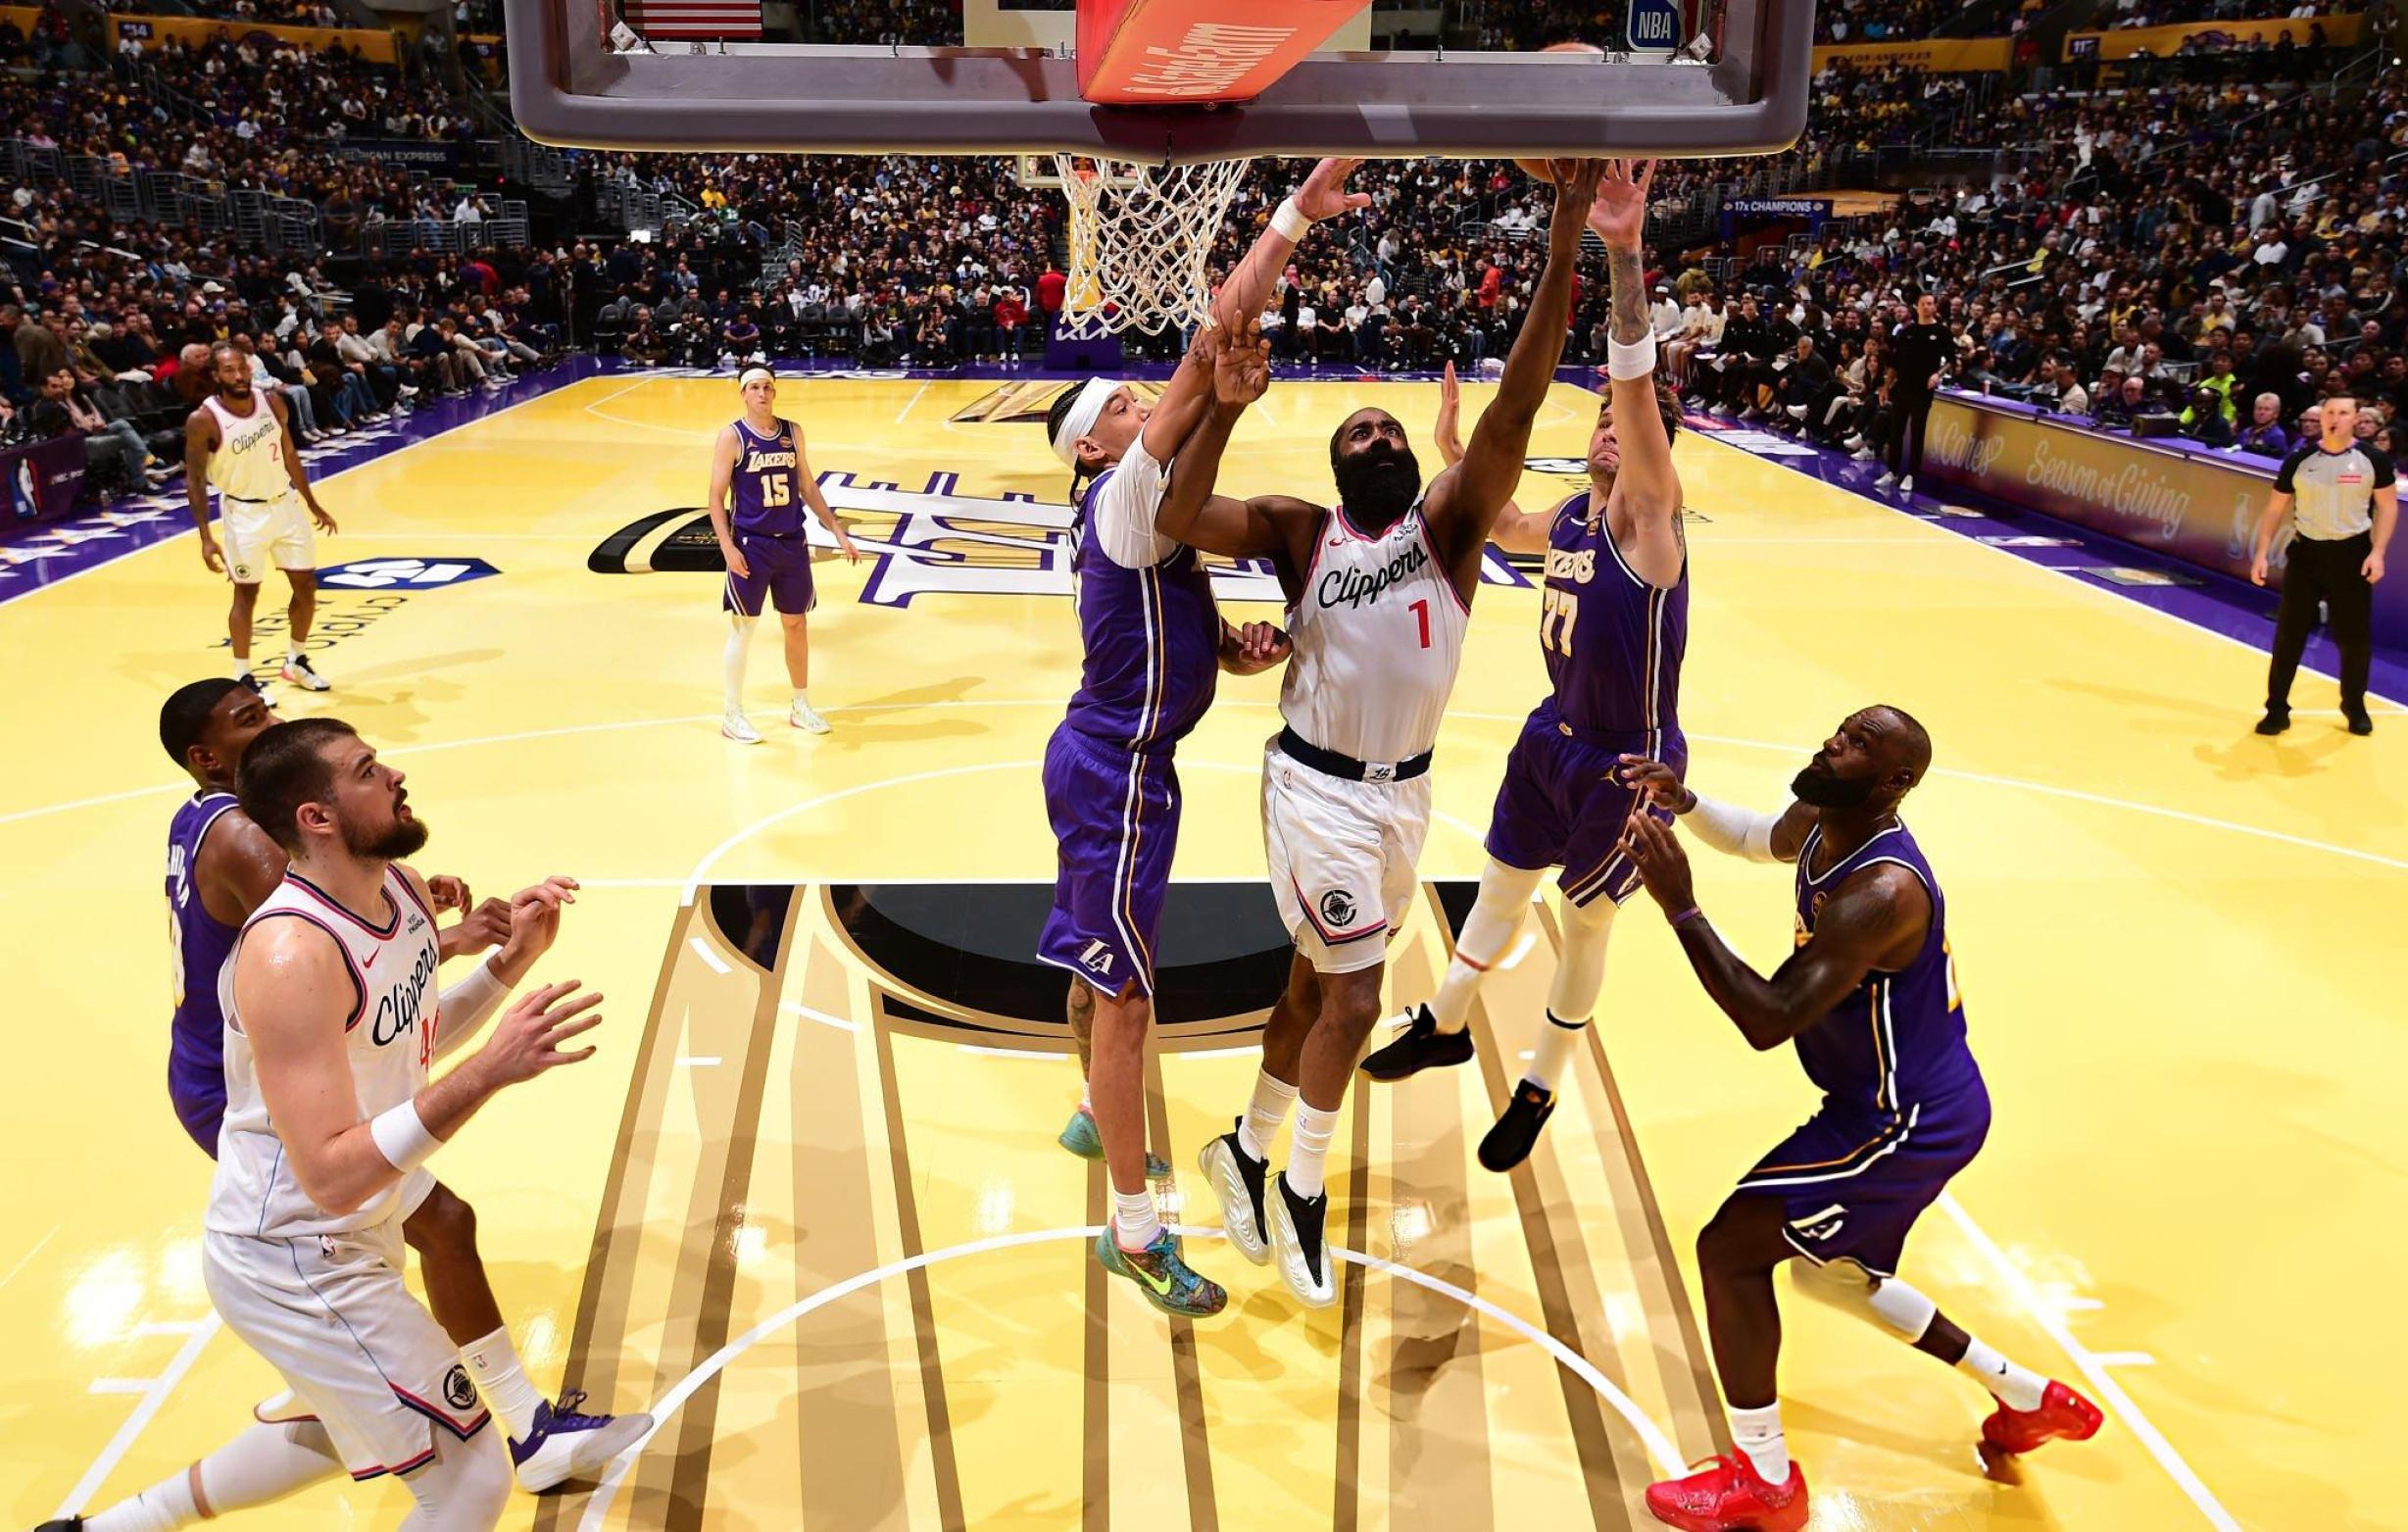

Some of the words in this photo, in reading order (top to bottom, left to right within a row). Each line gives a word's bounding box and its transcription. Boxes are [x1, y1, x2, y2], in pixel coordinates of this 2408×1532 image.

[1638, 11, 1671, 39] NBA
[395, 150, 448, 162] EXPRESS
[1735, 201, 1749, 212] 17x
[1750, 201, 1812, 213] CHAMPIONS
[232, 421, 275, 455] Clippers
[269, 442, 279, 463] 2
[745, 450, 796, 473] LAKERS
[761, 473, 791, 508] 15
[2026, 439, 2098, 502] Season
[2097, 473, 2116, 508] of
[2114, 464, 2190, 540] Giving
[1318, 541, 1428, 610] Clippers
[1408, 599, 1431, 649] 1
[1542, 586, 1578, 658] 77
[372, 937, 438, 1047] Clippers
